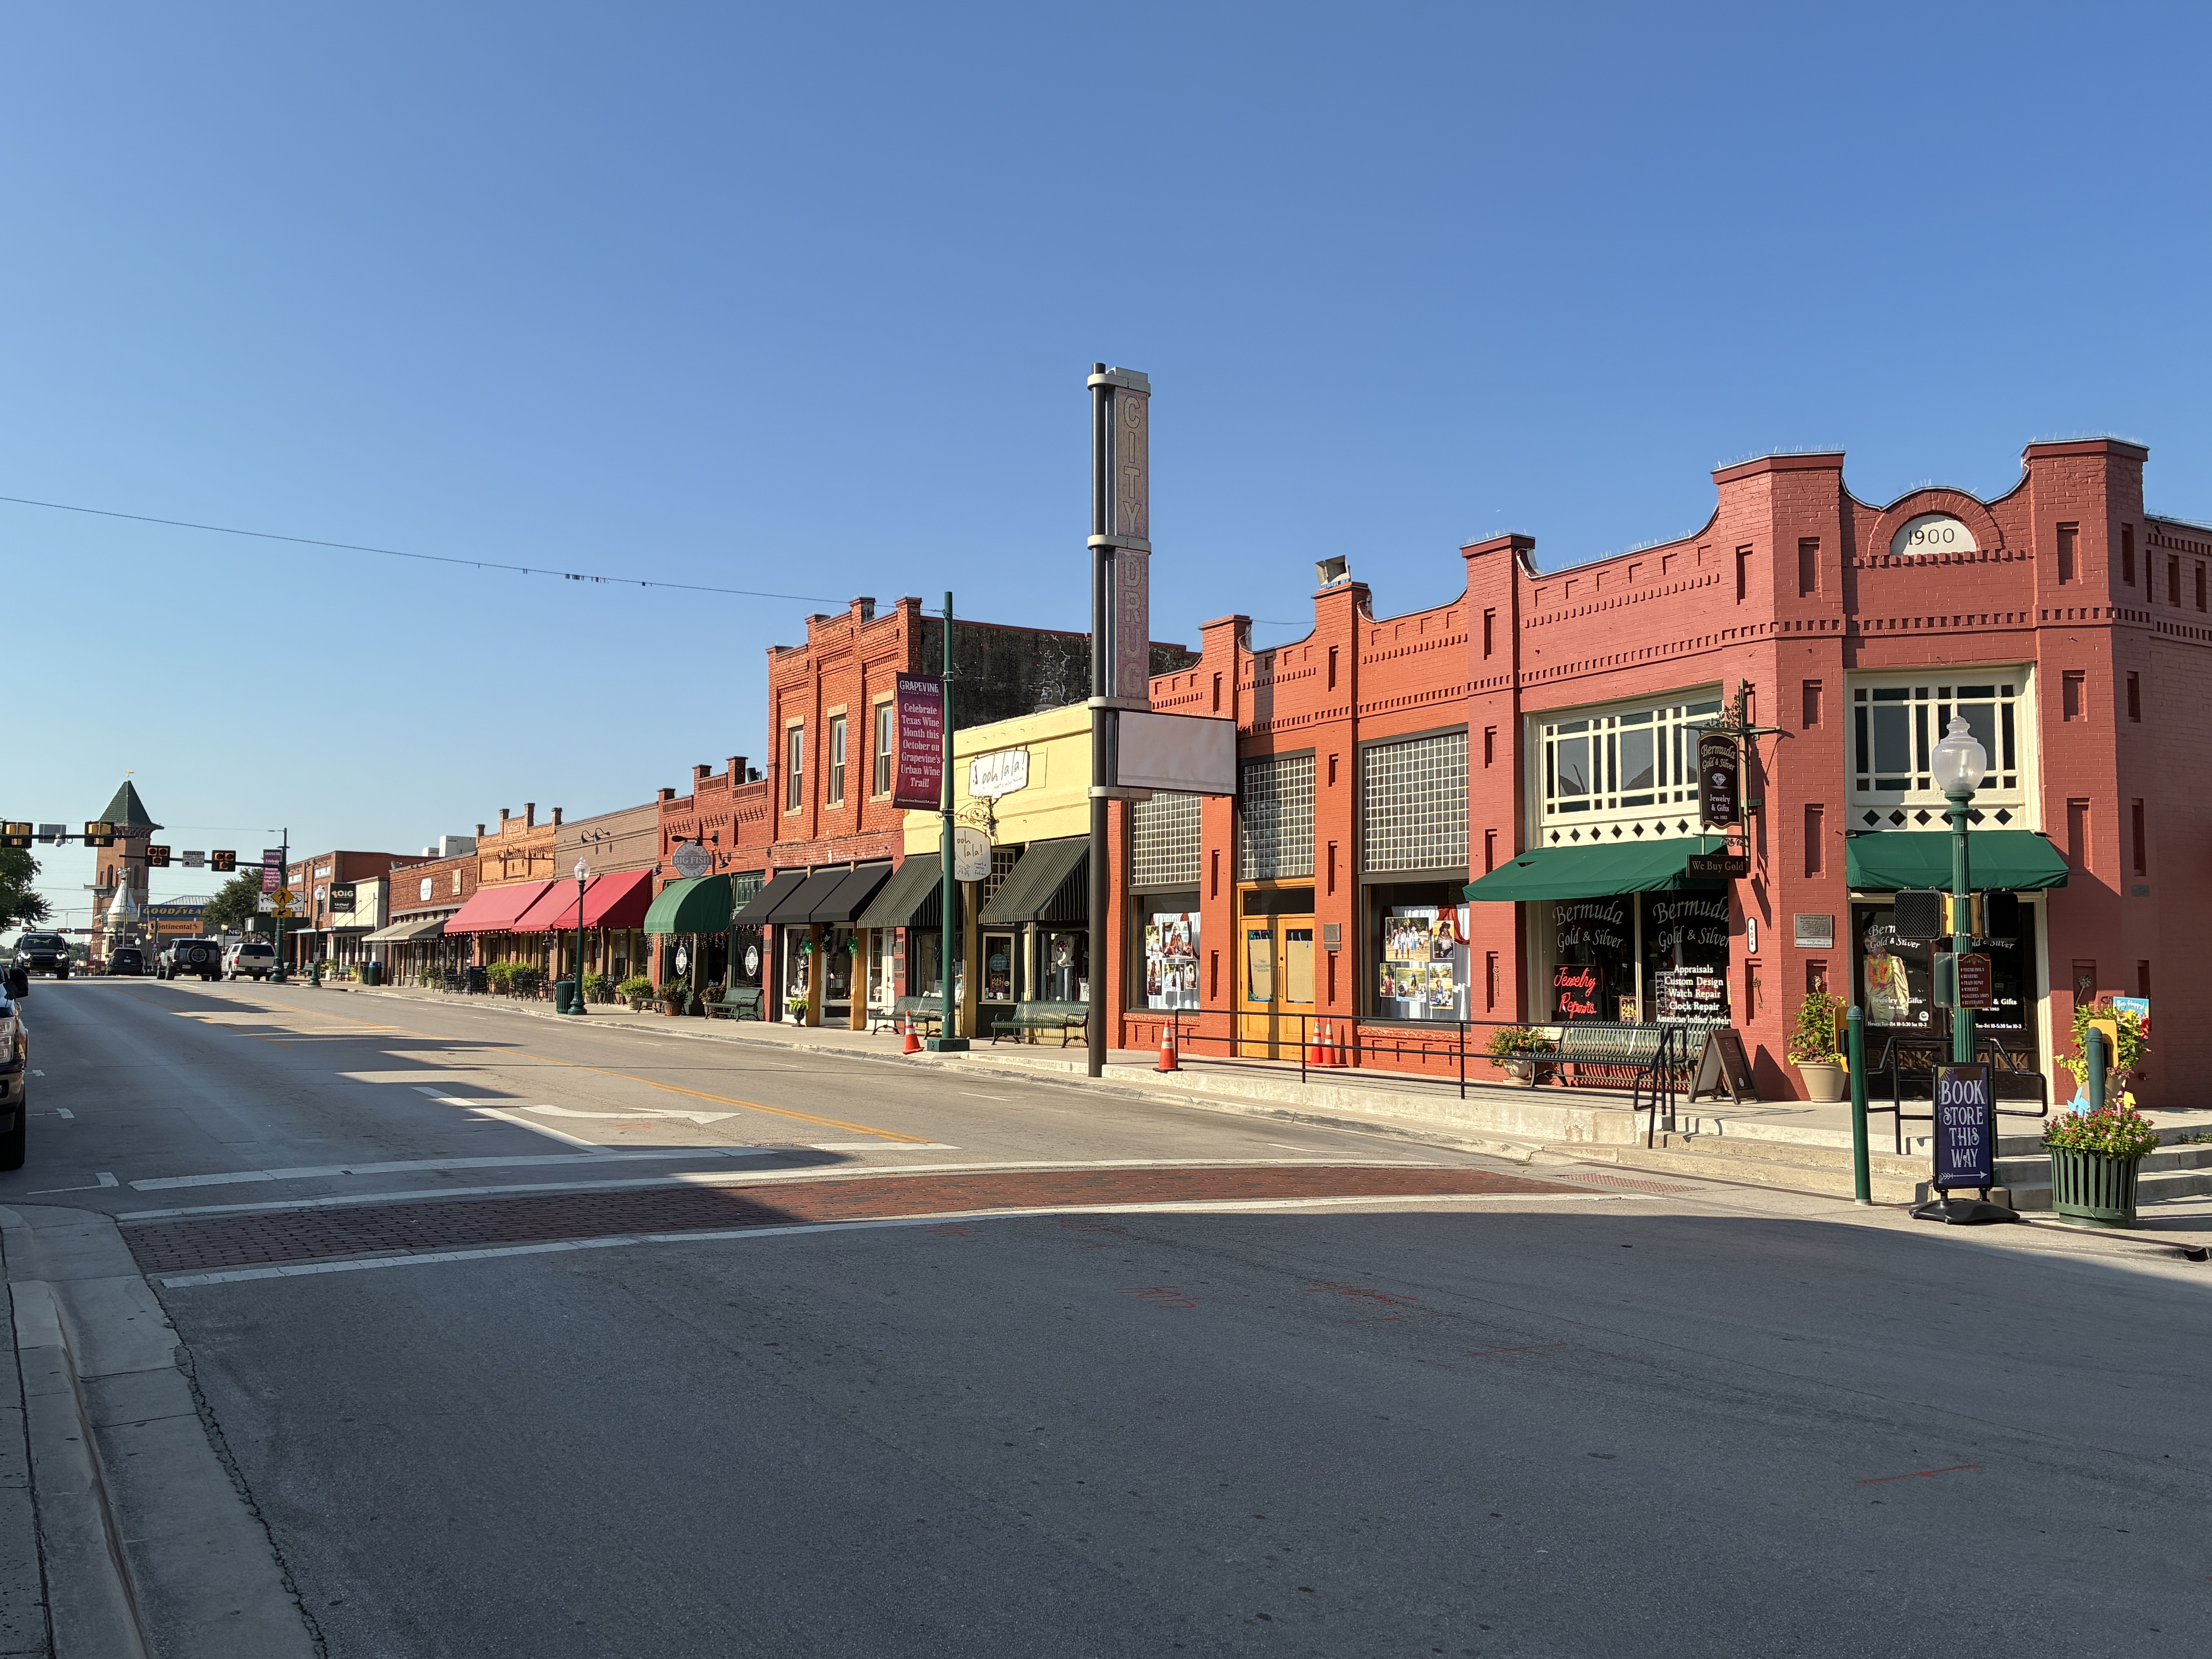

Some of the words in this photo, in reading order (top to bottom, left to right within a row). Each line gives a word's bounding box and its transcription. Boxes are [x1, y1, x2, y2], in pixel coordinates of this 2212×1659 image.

[1123, 396, 1141, 534] CITY
[1908, 528, 1954, 545] 1900
[1123, 554, 1142, 696] DRUG
[900, 680, 939, 693] GRAPEVINE
[904, 702, 937, 714] Celebrate
[901, 715, 921, 725] Texas
[922, 717, 939, 727] Wine
[903, 727, 925, 738] Month
[926, 729, 939, 739] this
[903, 739, 930, 750] October
[1701, 744, 1736, 759] Bermuda
[902, 752, 940, 764] Grapevine's
[1702, 757, 1715, 772] Gold
[1719, 758, 1735, 771] Silver
[901, 764, 921, 775] Urban
[923, 766, 940, 776] Wine
[910, 777, 929, 787] Trail!
[1709, 794, 1730, 804] Jewelry
[957, 830, 971, 844] ooh
[1692, 861, 1704, 870] We
[1707, 861, 1723, 872] Buy
[1724, 861, 1743, 871] Gold
[1553, 900, 1623, 926] Bermuda
[1558, 927, 1580, 953] Gold
[1583, 931, 1590, 941] &
[1592, 929, 1623, 948] Silver
[1659, 925, 1684, 952] Gold
[1687, 929, 1696, 940] &
[1870, 936, 1889, 951] Gold
[1896, 938, 1920, 948] Silver
[1674, 964, 1714, 975] Appraisals
[1554, 967, 1595, 996] Jewelry
[1665, 976, 1693, 985] Custom
[1697, 977, 1723, 988] Design
[1668, 988, 1692, 997] Watch
[1695, 989, 1721, 1000] Repair
[1669, 1001, 1692, 1010] Clock
[1694, 1001, 1719, 1012] Repair
[1656, 1014, 1686, 1022] American
[1687, 1015, 1707, 1024] Indian
[1977, 1053, 2028, 1069] ANK
[1941, 1080, 1985, 1104] BOOK
[1943, 1106, 1983, 1125] STORE
[1949, 1127, 1980, 1146] THIS
[1951, 1149, 1978, 1168] WAY
